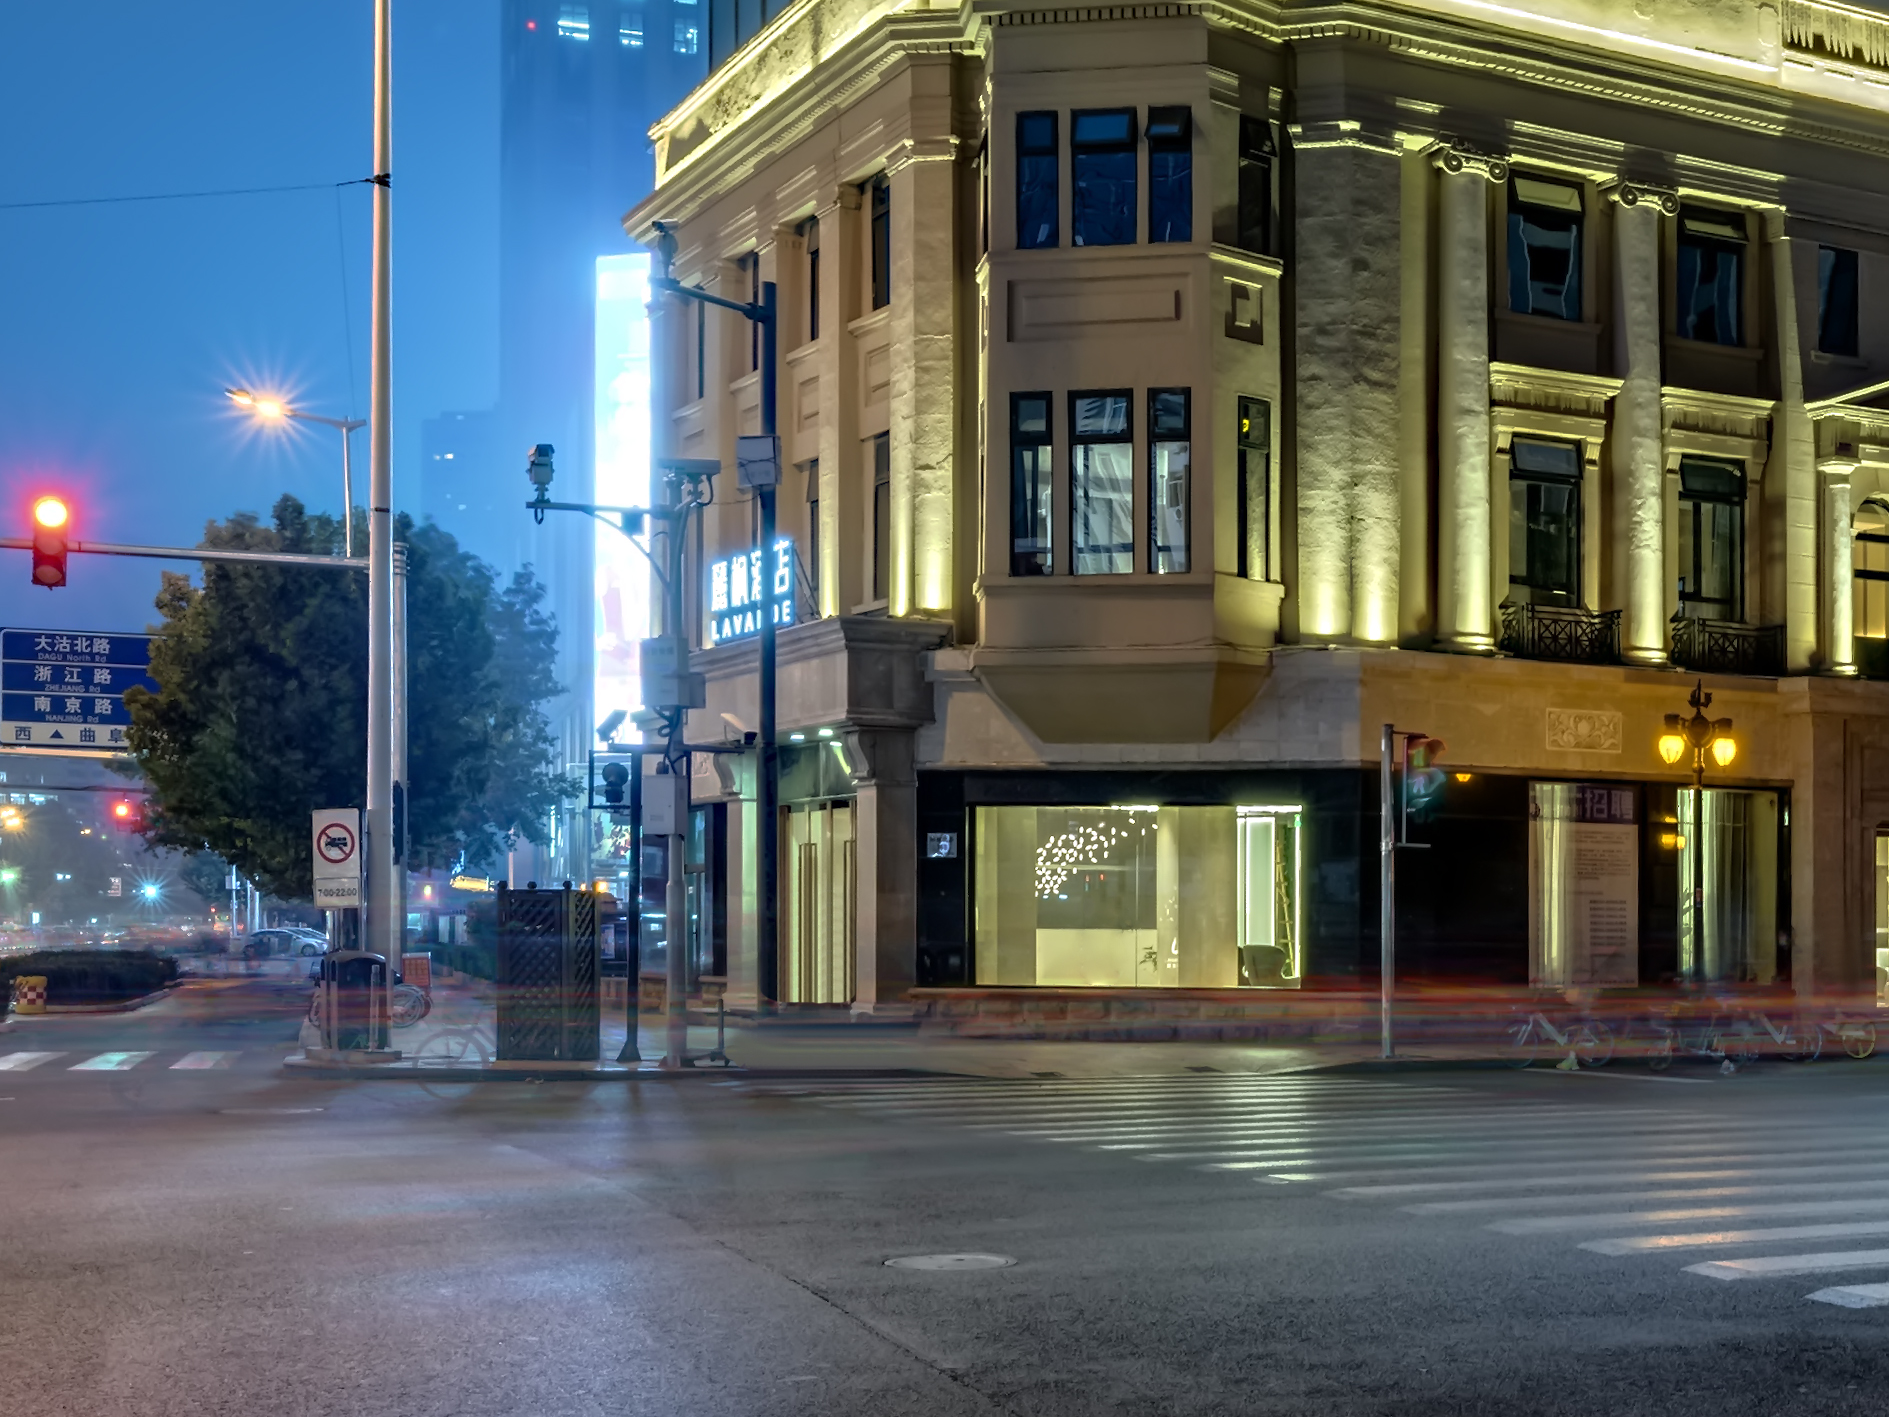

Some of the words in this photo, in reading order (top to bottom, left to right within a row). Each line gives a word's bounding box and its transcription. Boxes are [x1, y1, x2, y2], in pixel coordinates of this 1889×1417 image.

[34, 635, 111, 654] 大沽北路
[38, 652, 62, 661] DAGU
[66, 653, 91, 662] North
[95, 655, 106, 663] Rd
[34, 665, 112, 684] 浙江路
[44, 683, 86, 693] ZHEJIANG
[89, 685, 101, 693] Rd
[34, 696, 113, 715] 南京路
[45, 714, 83, 723] NANJING
[87, 715, 99, 723] Rd
[15, 726, 32, 741] 西
